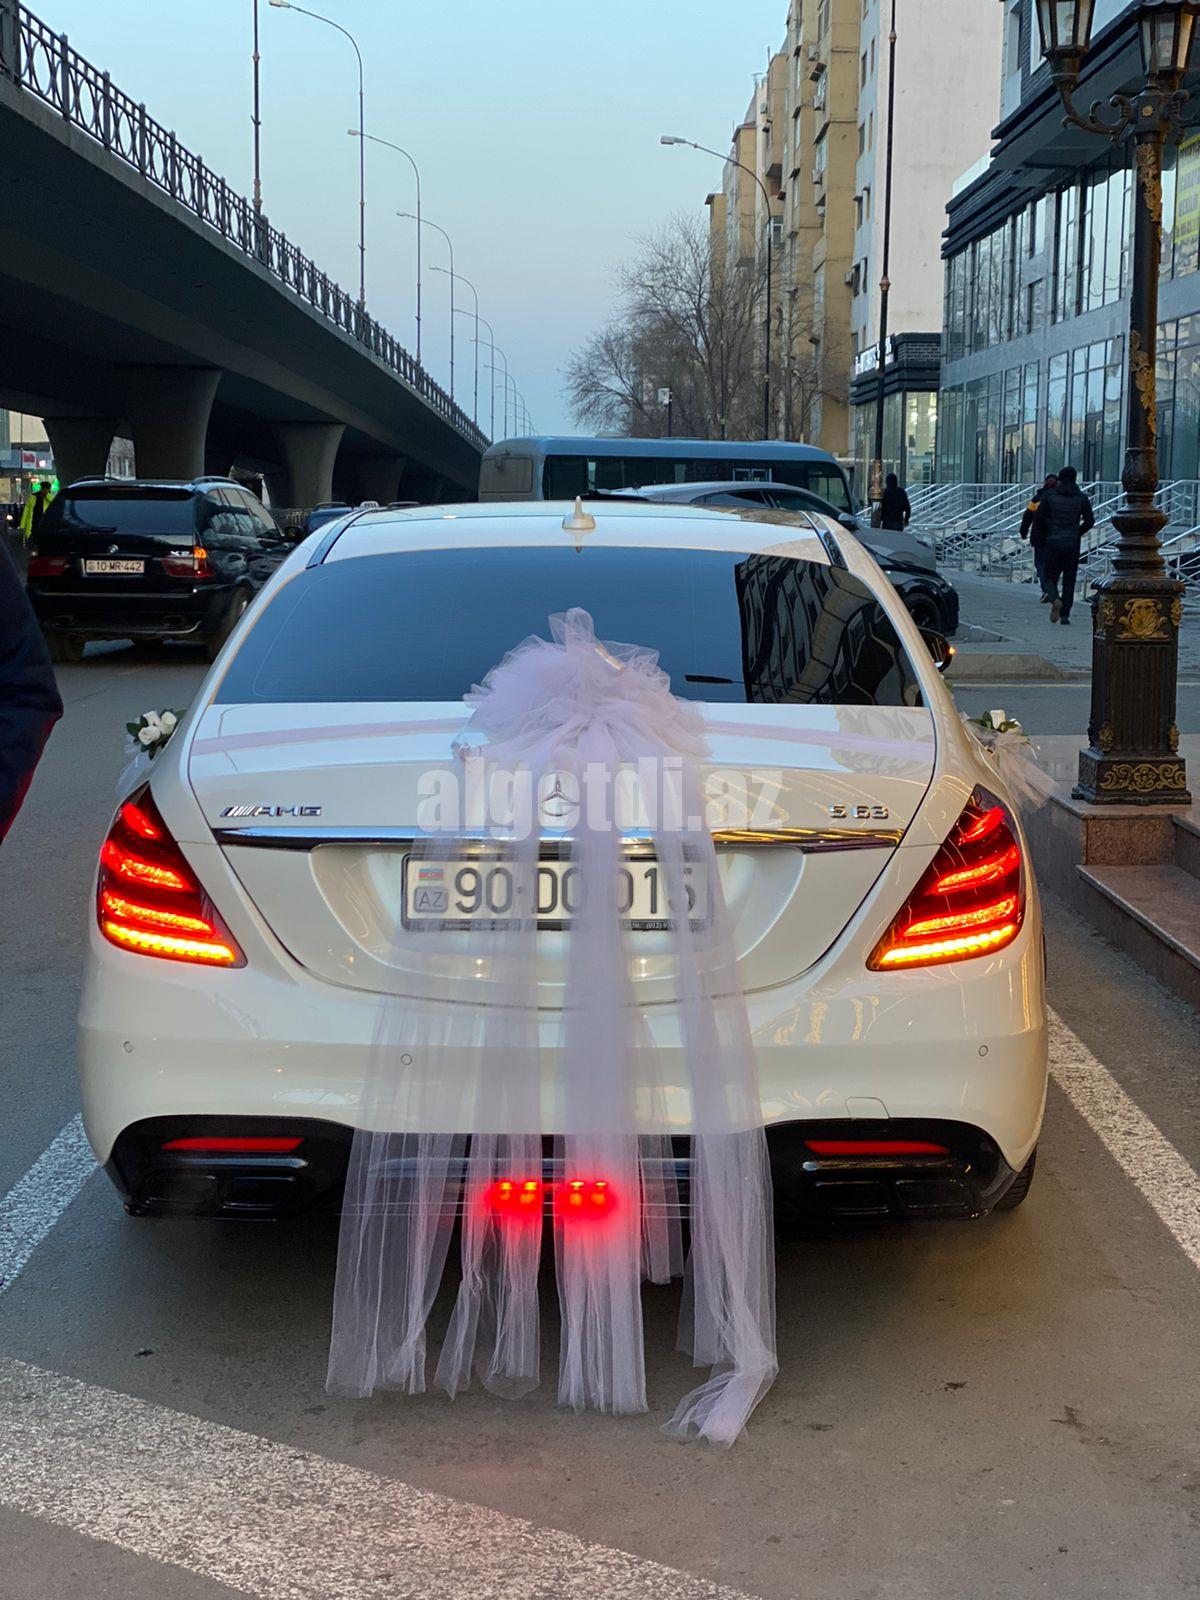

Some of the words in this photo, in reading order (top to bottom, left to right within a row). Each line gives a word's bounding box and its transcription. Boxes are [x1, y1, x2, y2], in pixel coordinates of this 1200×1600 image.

[96, 561, 142, 572] 10-MR-442
[252, 806, 321, 817] AMG
[829, 805, 847, 819] S
[852, 805, 889, 819] 63
[418, 887, 443, 908] AZ
